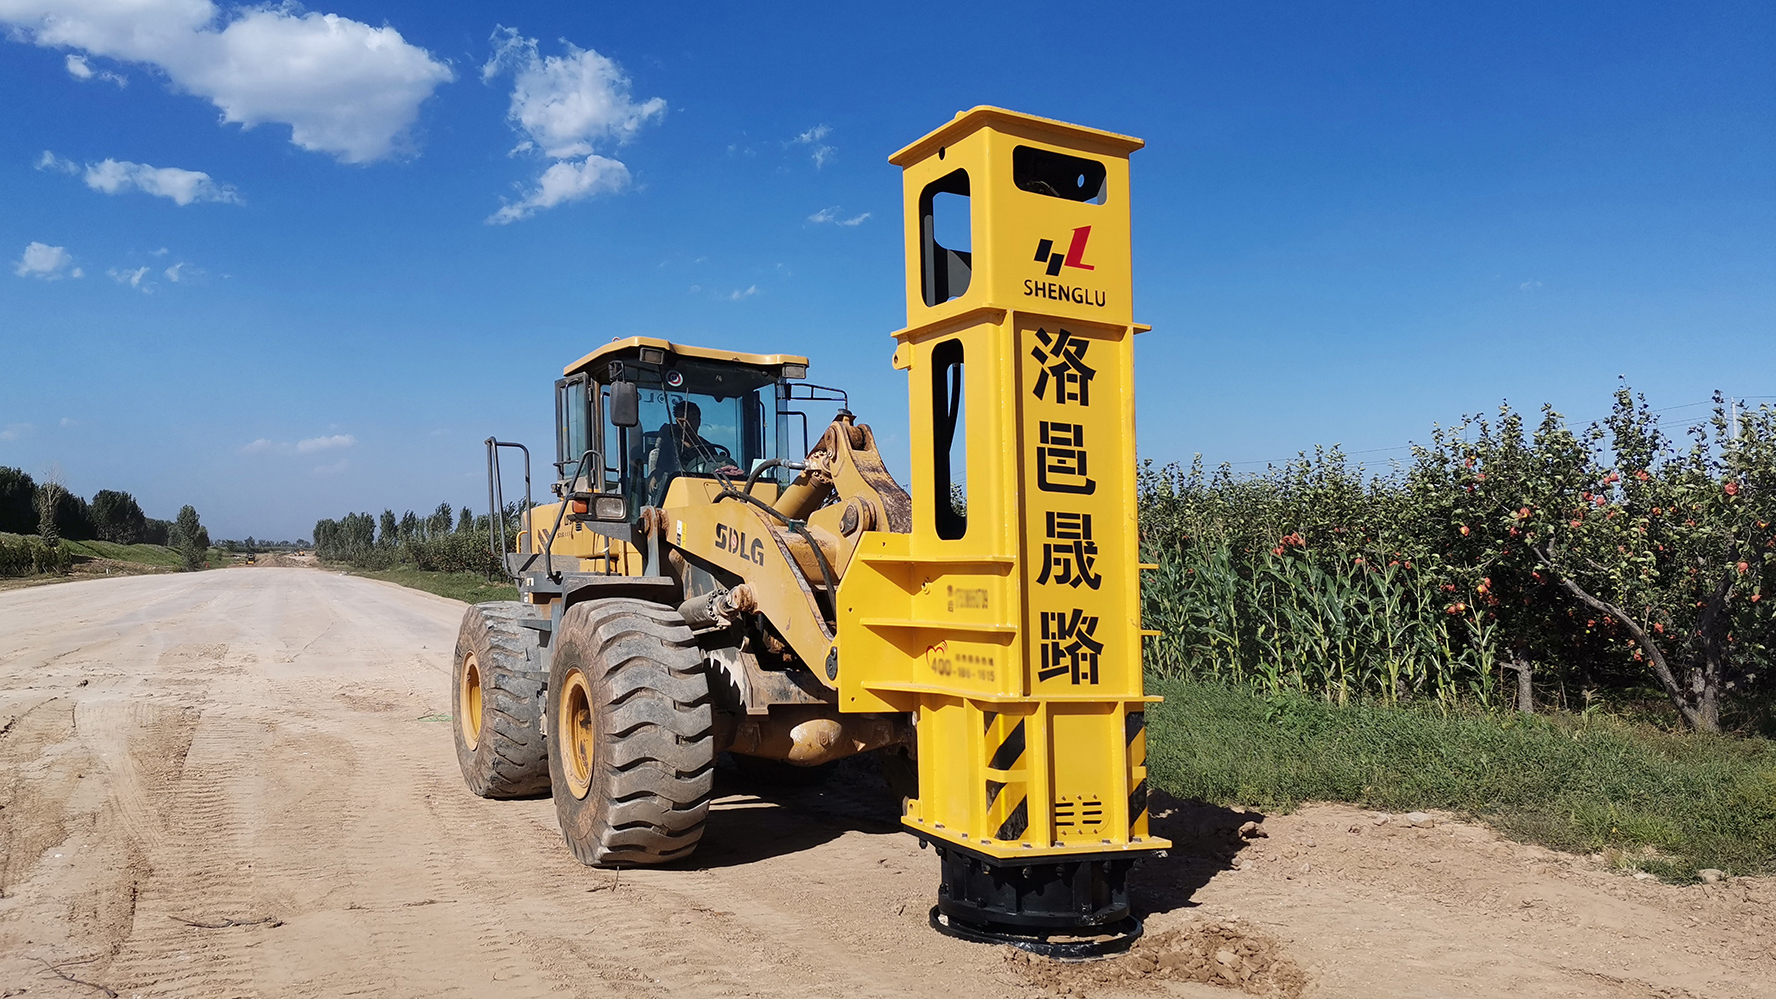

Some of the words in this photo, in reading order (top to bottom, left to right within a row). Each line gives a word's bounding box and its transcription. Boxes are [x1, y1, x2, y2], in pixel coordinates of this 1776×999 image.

[1023, 279, 1106, 307] SHENGLU
[1030, 326, 1105, 686] 洛邑晟路
[715, 522, 765, 567] SDLG
